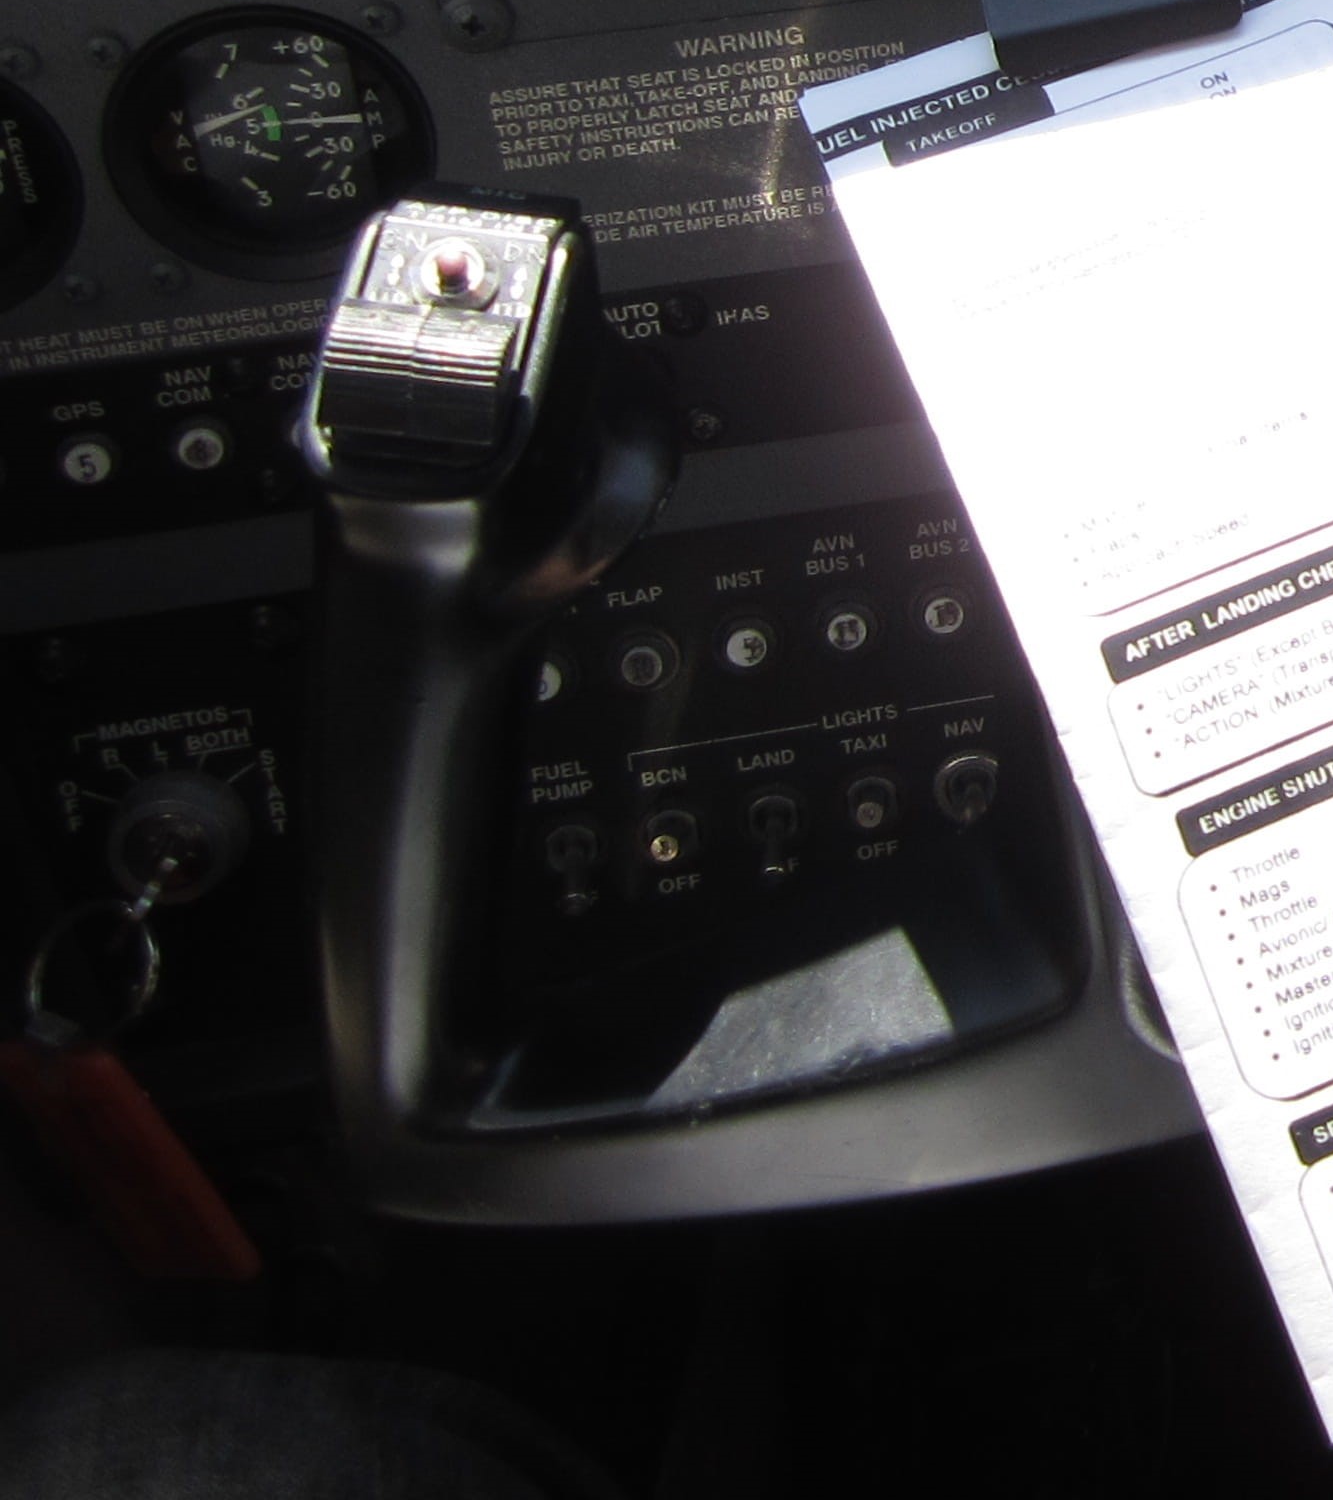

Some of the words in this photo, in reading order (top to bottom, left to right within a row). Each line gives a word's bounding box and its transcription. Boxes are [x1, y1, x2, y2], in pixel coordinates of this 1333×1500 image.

[674, 26, 805, 58] WARNING
[489, 82, 569, 106] ASSURE
[571, 76, 621, 96] THAT
[626, 70, 676, 90] SEAT
[705, 56, 785, 80] LOCKED
[816, 41, 905, 67] POSITION
[492, 102, 552, 122] PRIOR
[556, 99, 581, 115] TO
[739, 73, 778, 91] AND
[870, 83, 990, 134] INJECTED
[496, 123, 521, 140] TO
[526, 109, 630, 136] PROPERLY
[635, 100, 698, 121] LATCH
[703, 95, 751, 113] SEAT
[499, 133, 575, 155] SAFETY
[580, 115, 723, 148] INSTRUCTIONS
[728, 110, 769, 127] CAN
[906, 113, 998, 153] TAKEOFF
[503, 150, 573, 172] INJURY
[577, 146, 607, 162] OR
[611, 138, 681, 159] DEATH.
[688, 200, 718, 217] KIT
[722, 192, 775, 212] MUST
[628, 223, 660, 240] AIR
[664, 206, 803, 235] TEMPERATURE
[52, 400, 105, 422] GPS
[157, 385, 213, 408] COM
[811, 533, 856, 554] AVN
[916, 518, 958, 540] AVN
[908, 540, 951, 561] BUS
[715, 569, 765, 592] INST
[805, 555, 850, 577] BUS
[606, 585, 663, 608] FLAP
[1125, 620, 1196, 663] AFTER
[1203, 579, 1296, 631] LANDING
[97, 705, 230, 742] MAGNETOS
[821, 703, 898, 731] LIGHTS
[943, 717, 986, 739] NAV
[840, 733, 888, 755] TAXI
[530, 760, 590, 783] FUEL
[737, 749, 796, 773] LAND
[531, 779, 594, 804] PUMP
[640, 765, 688, 788] BCN
[1198, 788, 1280, 836] ENGINE
[1231, 846, 1301, 884] Throttle
[1240, 877, 1291, 911] Mags
[1247, 893, 1318, 933] Throttle
[1265, 944, 1333, 982] Mixture
